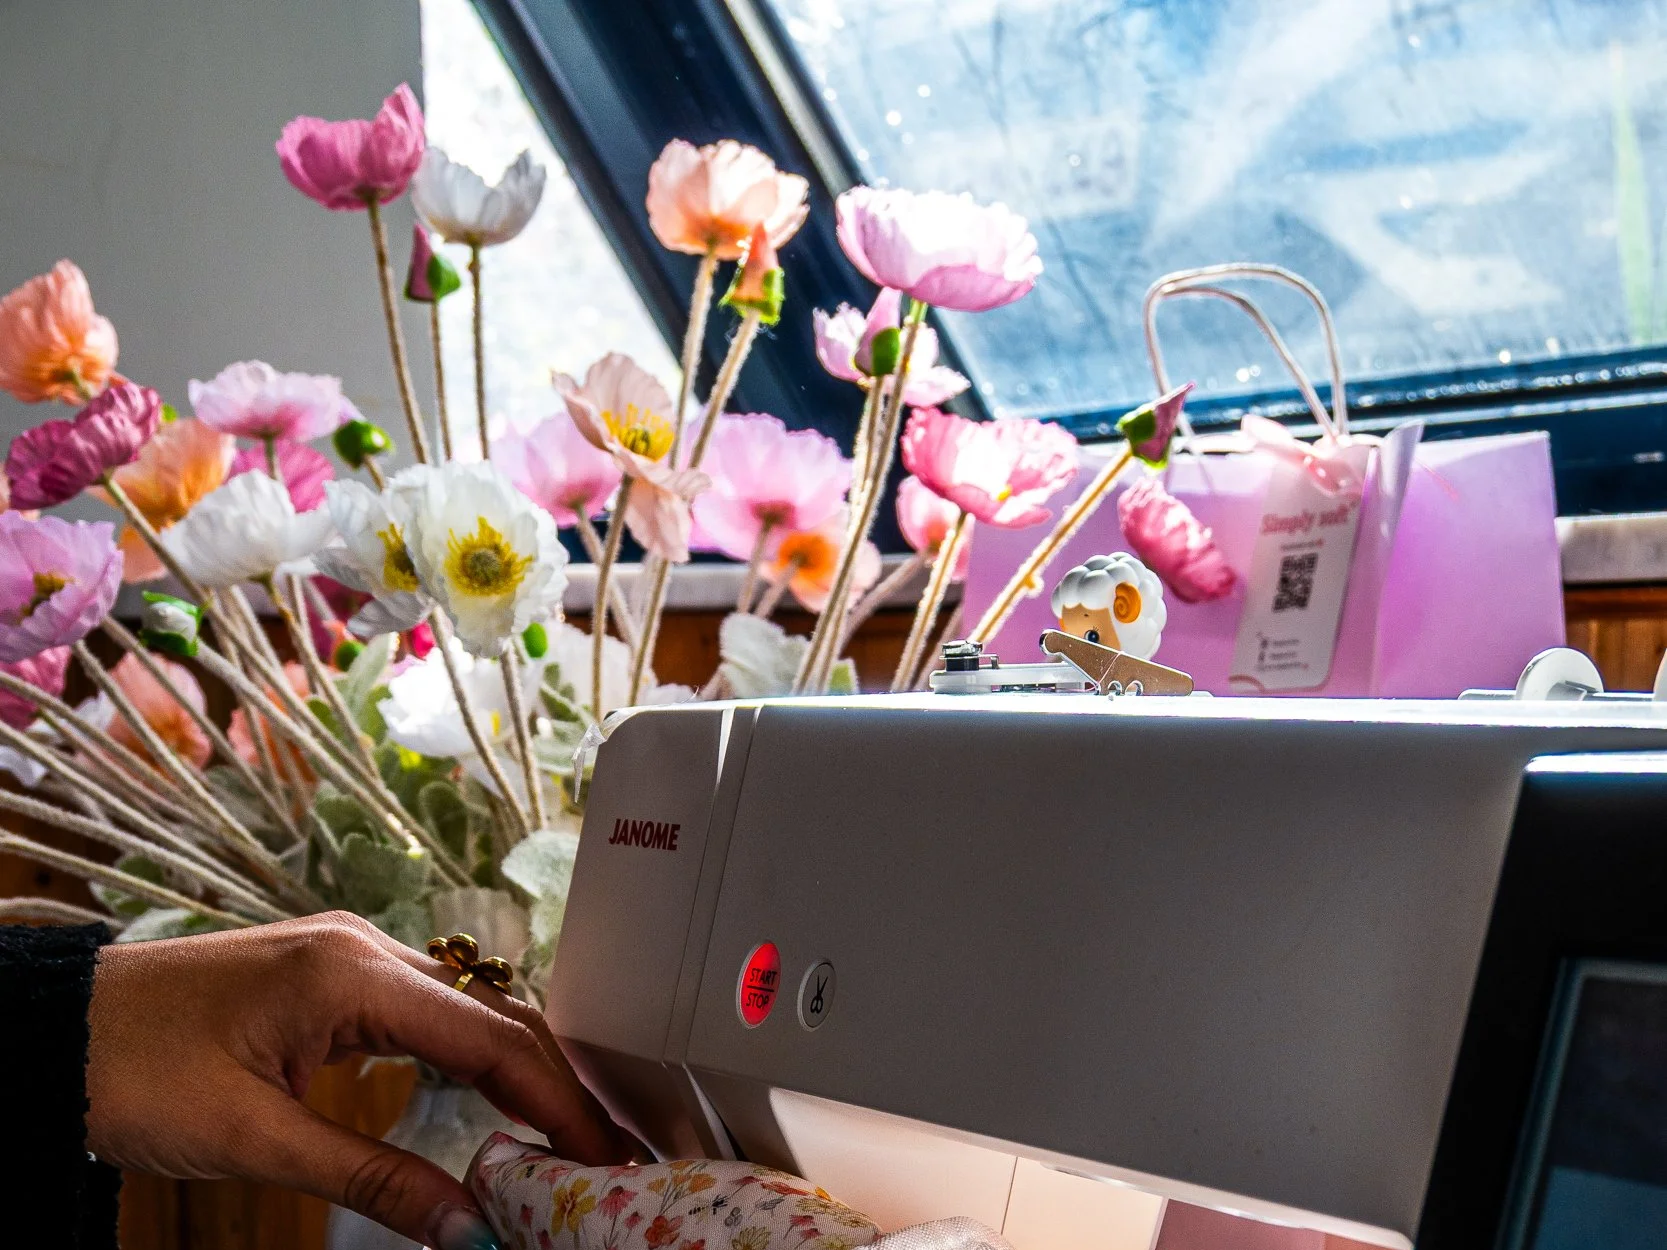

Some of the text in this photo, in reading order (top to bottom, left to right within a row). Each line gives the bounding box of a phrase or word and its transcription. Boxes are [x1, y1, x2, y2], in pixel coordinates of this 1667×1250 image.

[608, 817, 681, 851] JANOME
[749, 966, 778, 986] START
[745, 992, 770, 1010] STOP
